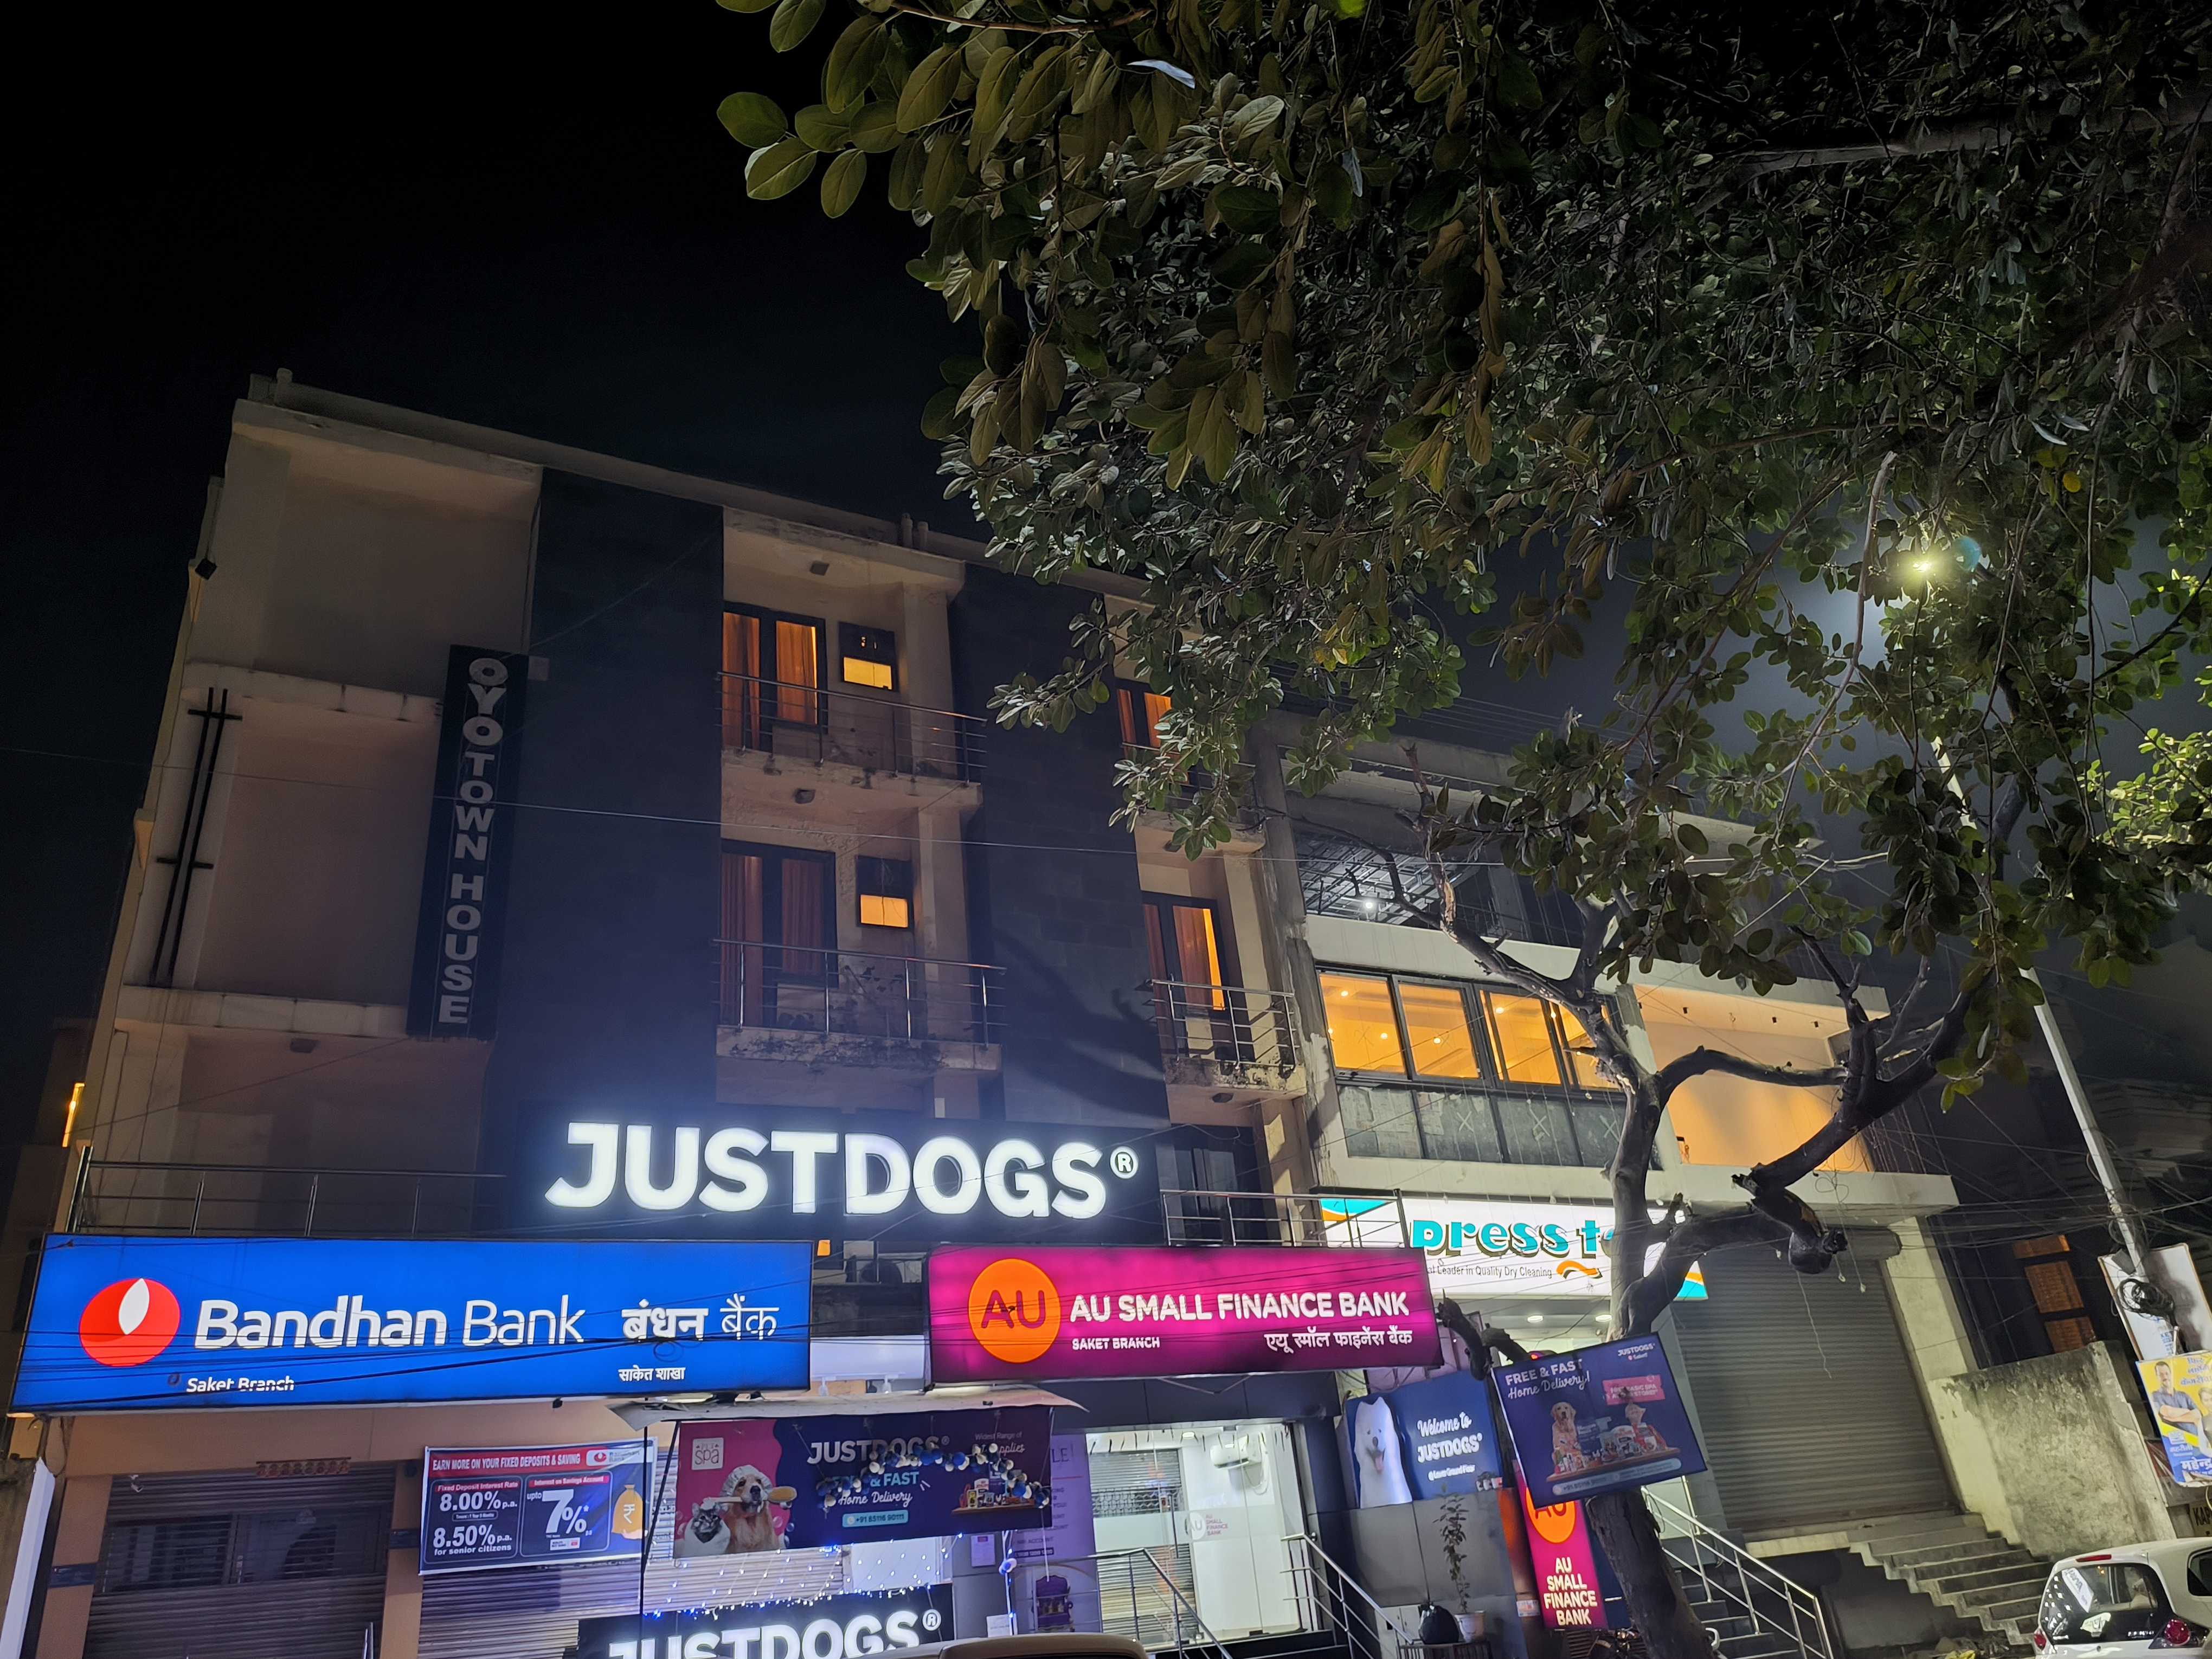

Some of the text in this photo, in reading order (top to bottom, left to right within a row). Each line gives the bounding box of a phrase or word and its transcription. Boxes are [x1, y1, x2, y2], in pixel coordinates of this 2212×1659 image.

[463, 657, 508, 746] OYO
[1410, 1219, 1570, 1258] press
[1437, 1265, 1464, 1275] Leader
[1466, 1265, 1473, 1274] in
[1475, 1265, 1502, 1278] Quality
[1504, 1266, 1518, 1279] Dry
[1520, 1267, 1552, 1279] Cleaning
[981, 1290, 1046, 1329] AU
[1070, 1291, 1410, 1323] AU SMALL FINANCE BANK
[194, 1294, 586, 1349] Bandhan Bank
[621, 1293, 780, 1342] बंधन बैंक
[1072, 1336, 1160, 1351] SAKET BRANCH
[1264, 1333, 1294, 1354] एयू
[1292, 1326, 1330, 1348] स्मॉल
[1387, 1324, 1413, 1345] बैंक
[618, 1365, 686, 1382] साकेत शाखा
[1505, 1358, 1583, 1386] FREE & FAST
[186, 1375, 295, 1393] Saket Branch
[1508, 1370, 1591, 1399] Home Delivery!
[1417, 1411, 1472, 1437] Welcome to
[433, 1459, 451, 1471] EARN
[452, 1458, 471, 1470] MORE
[471, 1458, 481, 1469] ON
[482, 1457, 500, 1469] YOUR
[500, 1456, 519, 1468] FIXED
[520, 1454, 550, 1467] DEPOSITS
[557, 1453, 581, 1465] SAVING
[455, 1483, 479, 1491] Deposit
[884, 1471, 919, 1487] FAST
[440, 1490, 501, 1512] 8.00%
[527, 1491, 542, 1501] upto
[838, 1491, 913, 1508] Home Delivery
[433, 1524, 496, 1548] 8.50%
[449, 1546, 476, 1555] senior
[478, 1544, 512, 1553] citizens
[1555, 1557, 1572, 1574] AU
[1546, 1573, 1587, 1592] SMALL
[1543, 1590, 1598, 1609] FINANCE
[1556, 1609, 1592, 1626] BANK
